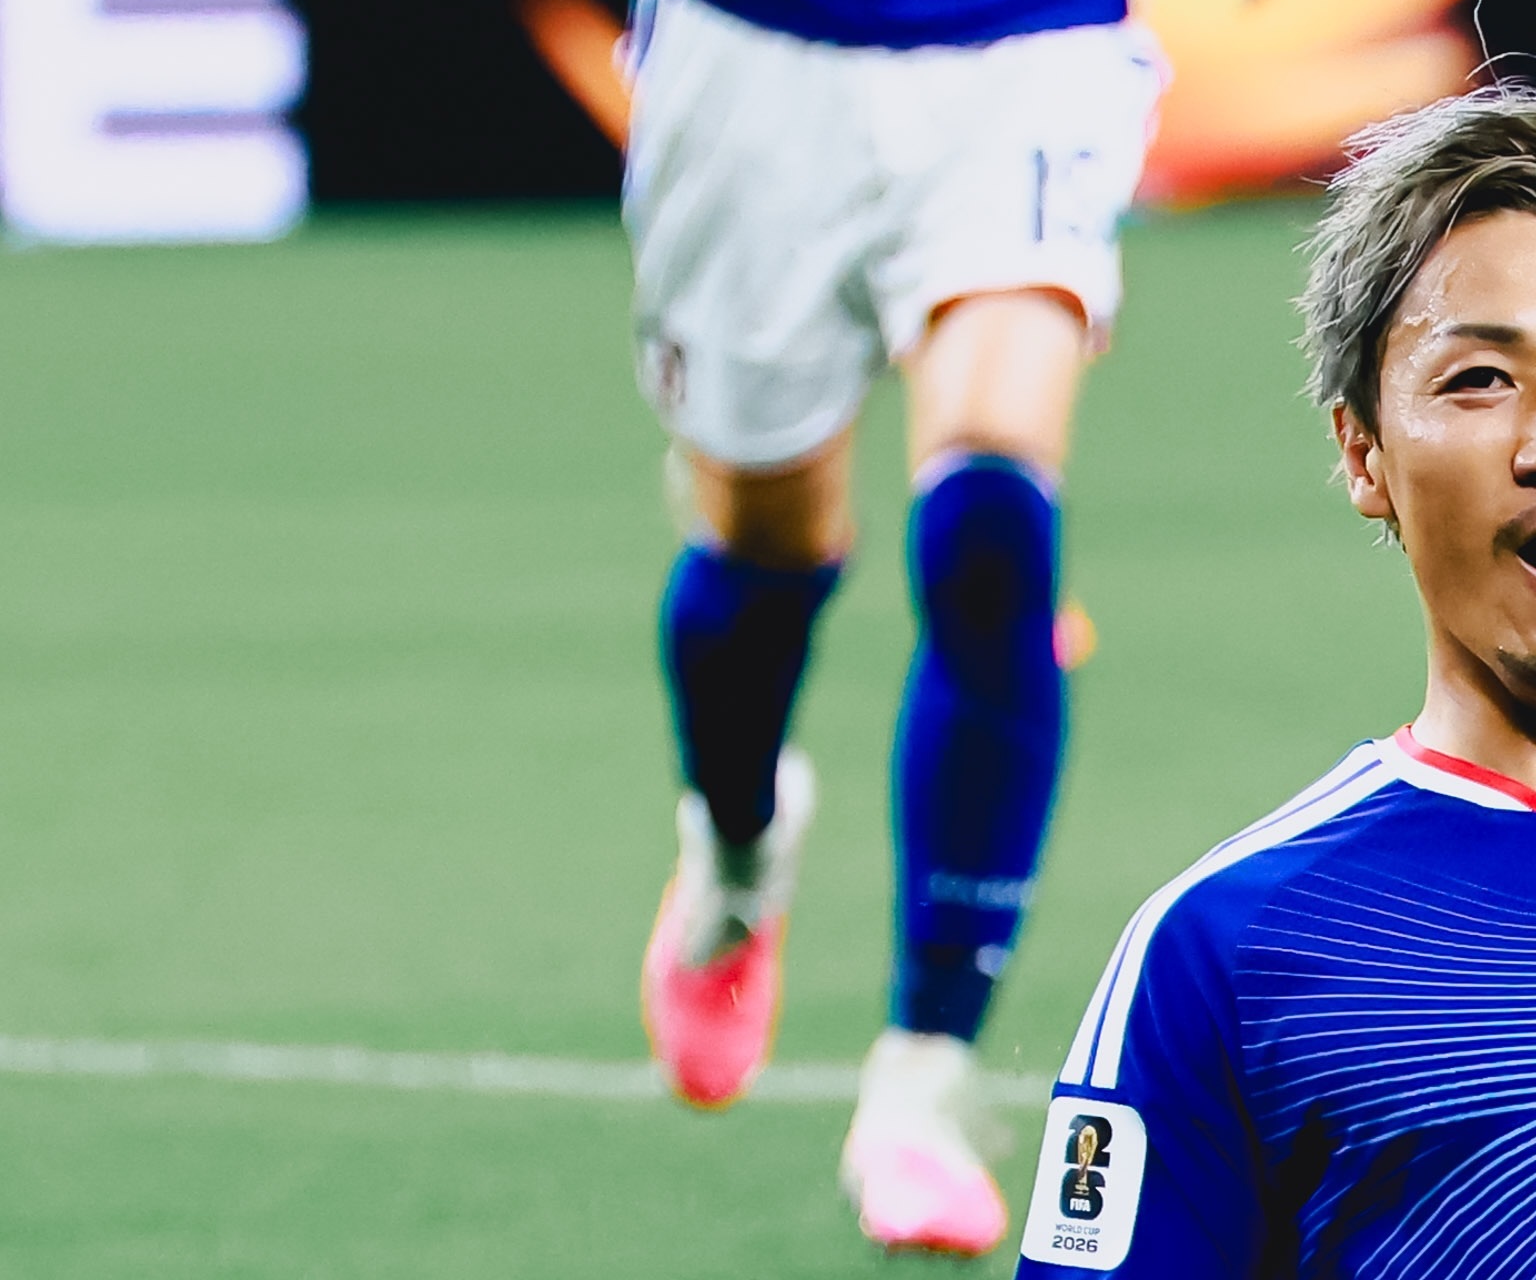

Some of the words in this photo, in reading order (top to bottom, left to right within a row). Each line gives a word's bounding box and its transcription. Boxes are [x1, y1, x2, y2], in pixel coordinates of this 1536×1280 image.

[1069, 1197, 1092, 1212] FIFA
[1055, 1223, 1083, 1235] WORLD
[1083, 1226, 1101, 1236] CUP
[1052, 1235, 1099, 1253] 2026
